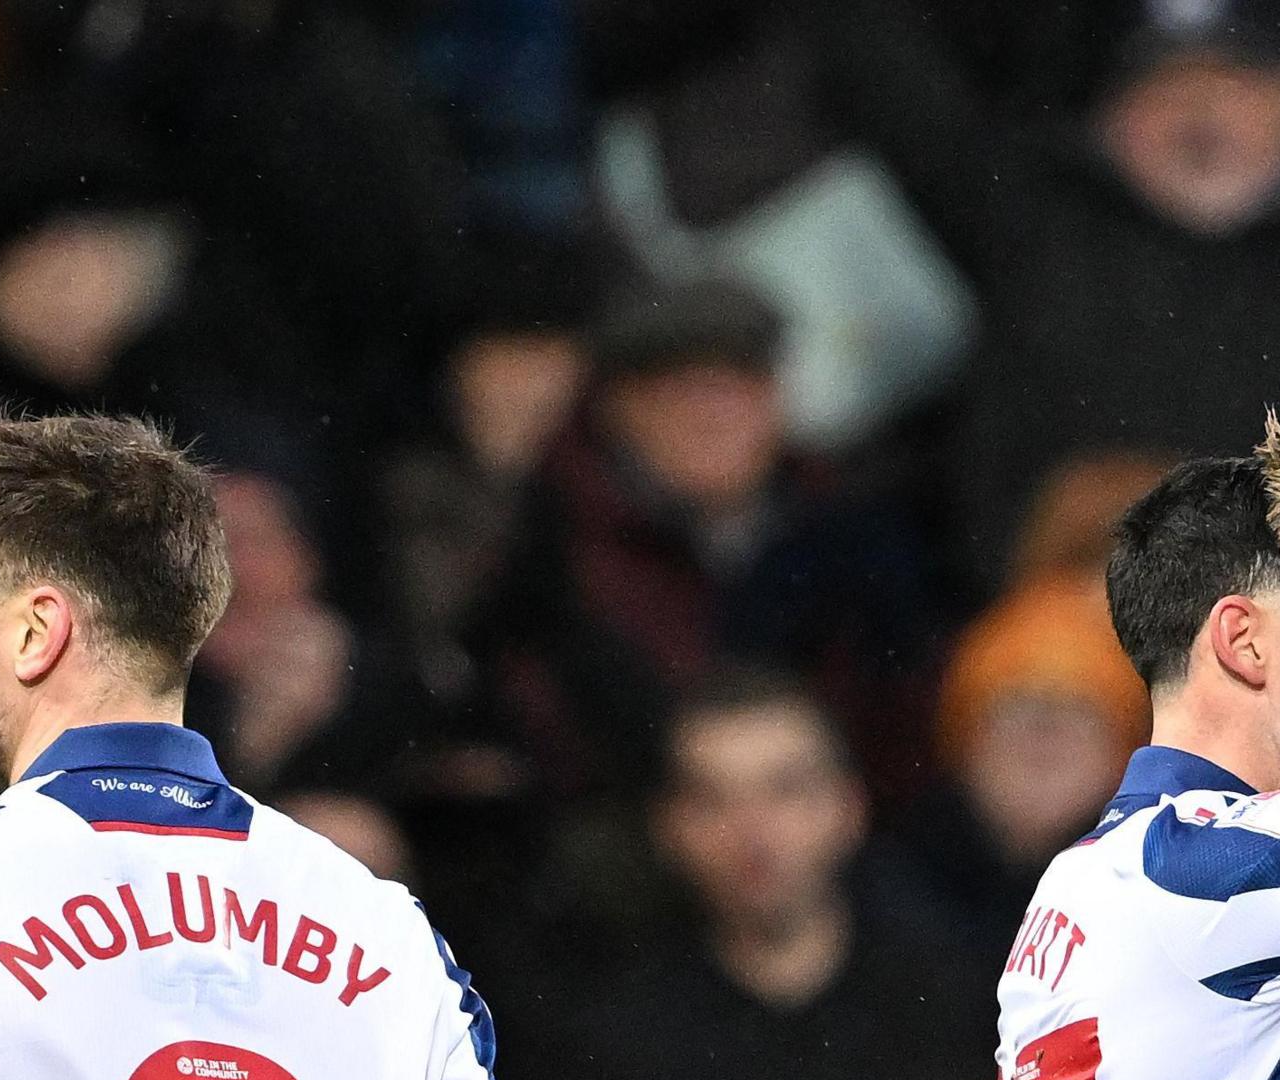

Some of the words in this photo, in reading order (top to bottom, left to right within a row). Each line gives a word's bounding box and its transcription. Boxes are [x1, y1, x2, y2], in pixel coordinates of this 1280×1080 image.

[91, 777, 128, 792] We
[129, 781, 157, 794] are
[159, 785, 214, 810] Albion
[195, 1067, 248, 1080] COMMUNITY
